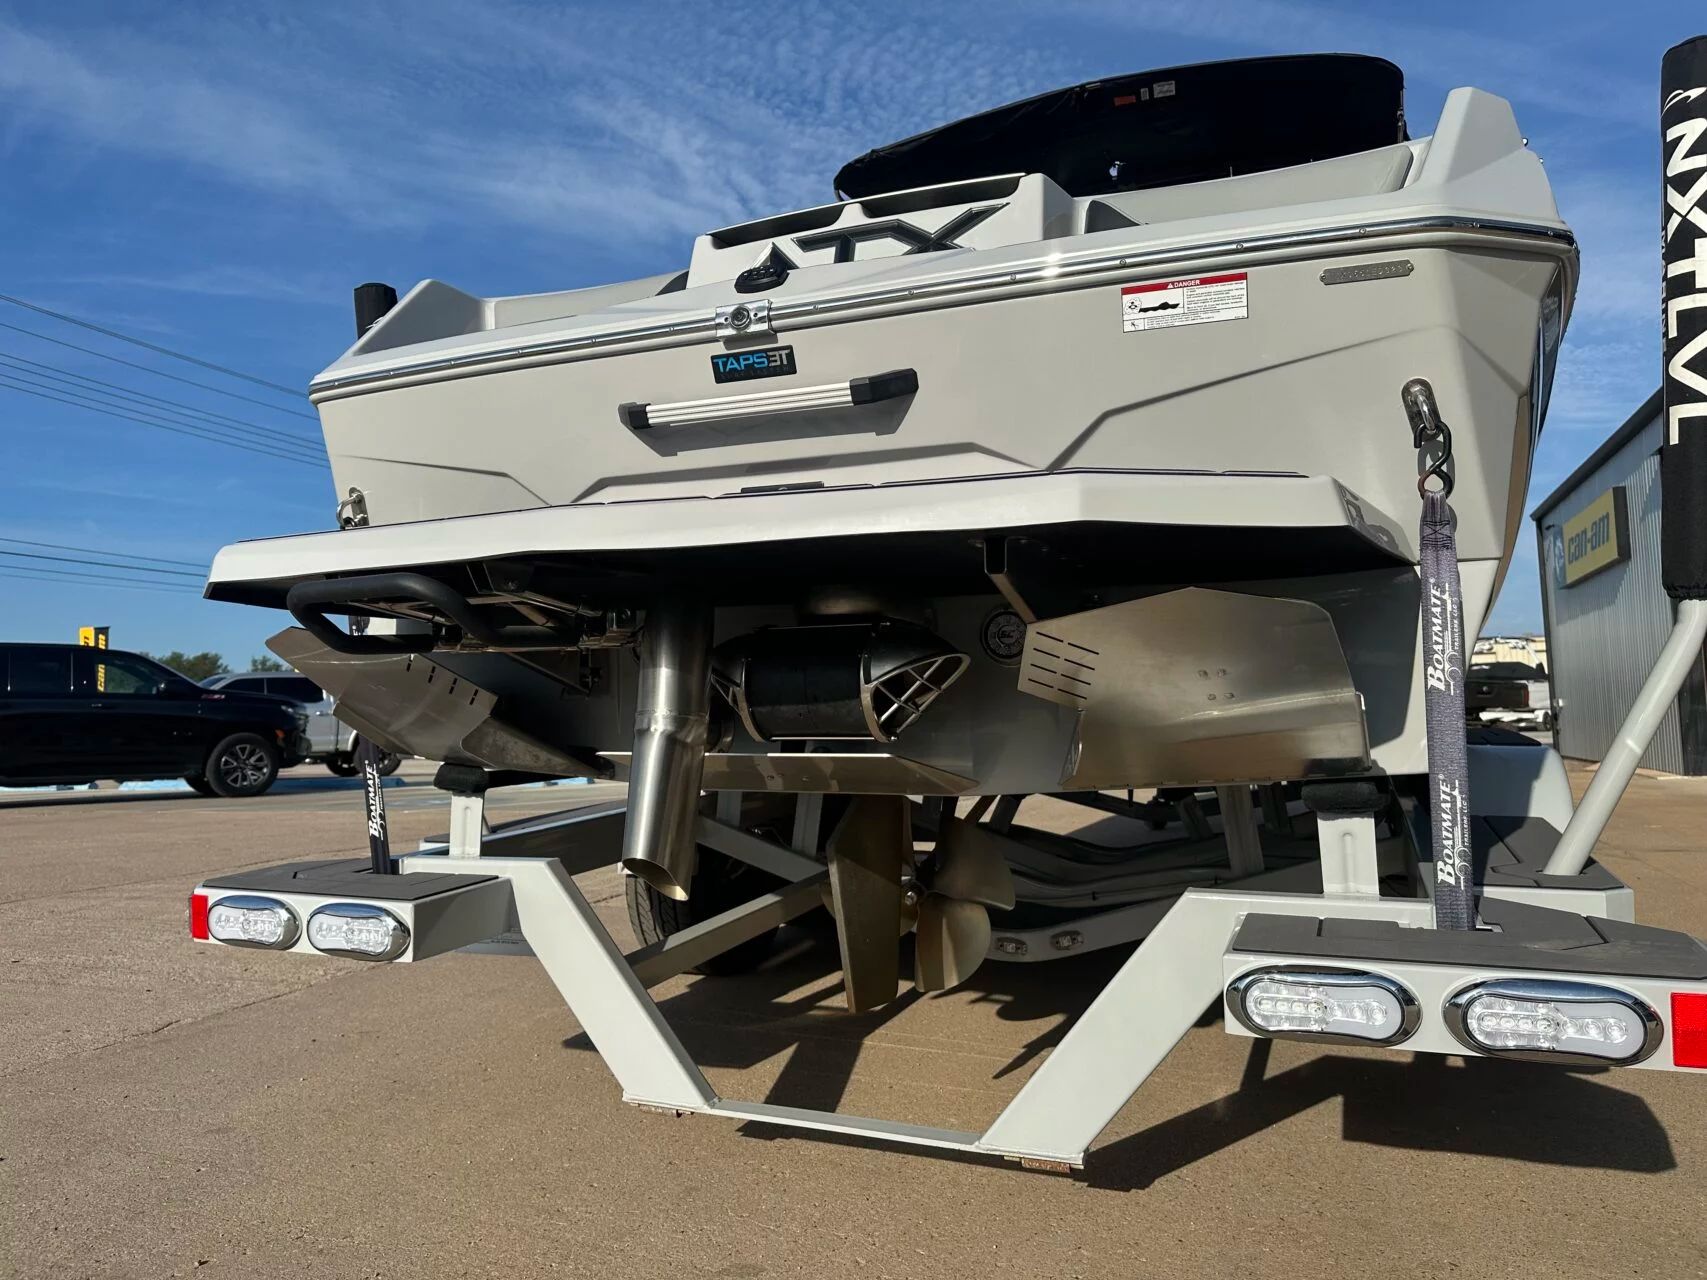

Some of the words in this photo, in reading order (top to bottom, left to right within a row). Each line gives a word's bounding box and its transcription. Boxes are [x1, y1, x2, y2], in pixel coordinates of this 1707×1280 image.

[1174, 280, 1200, 288] DANGER
[1568, 511, 1610, 565] can-am
[1427, 583, 1446, 692] BOATMATE
[366, 764, 380, 837] BOATMATE
[1437, 780, 1456, 886] BOATMATE
